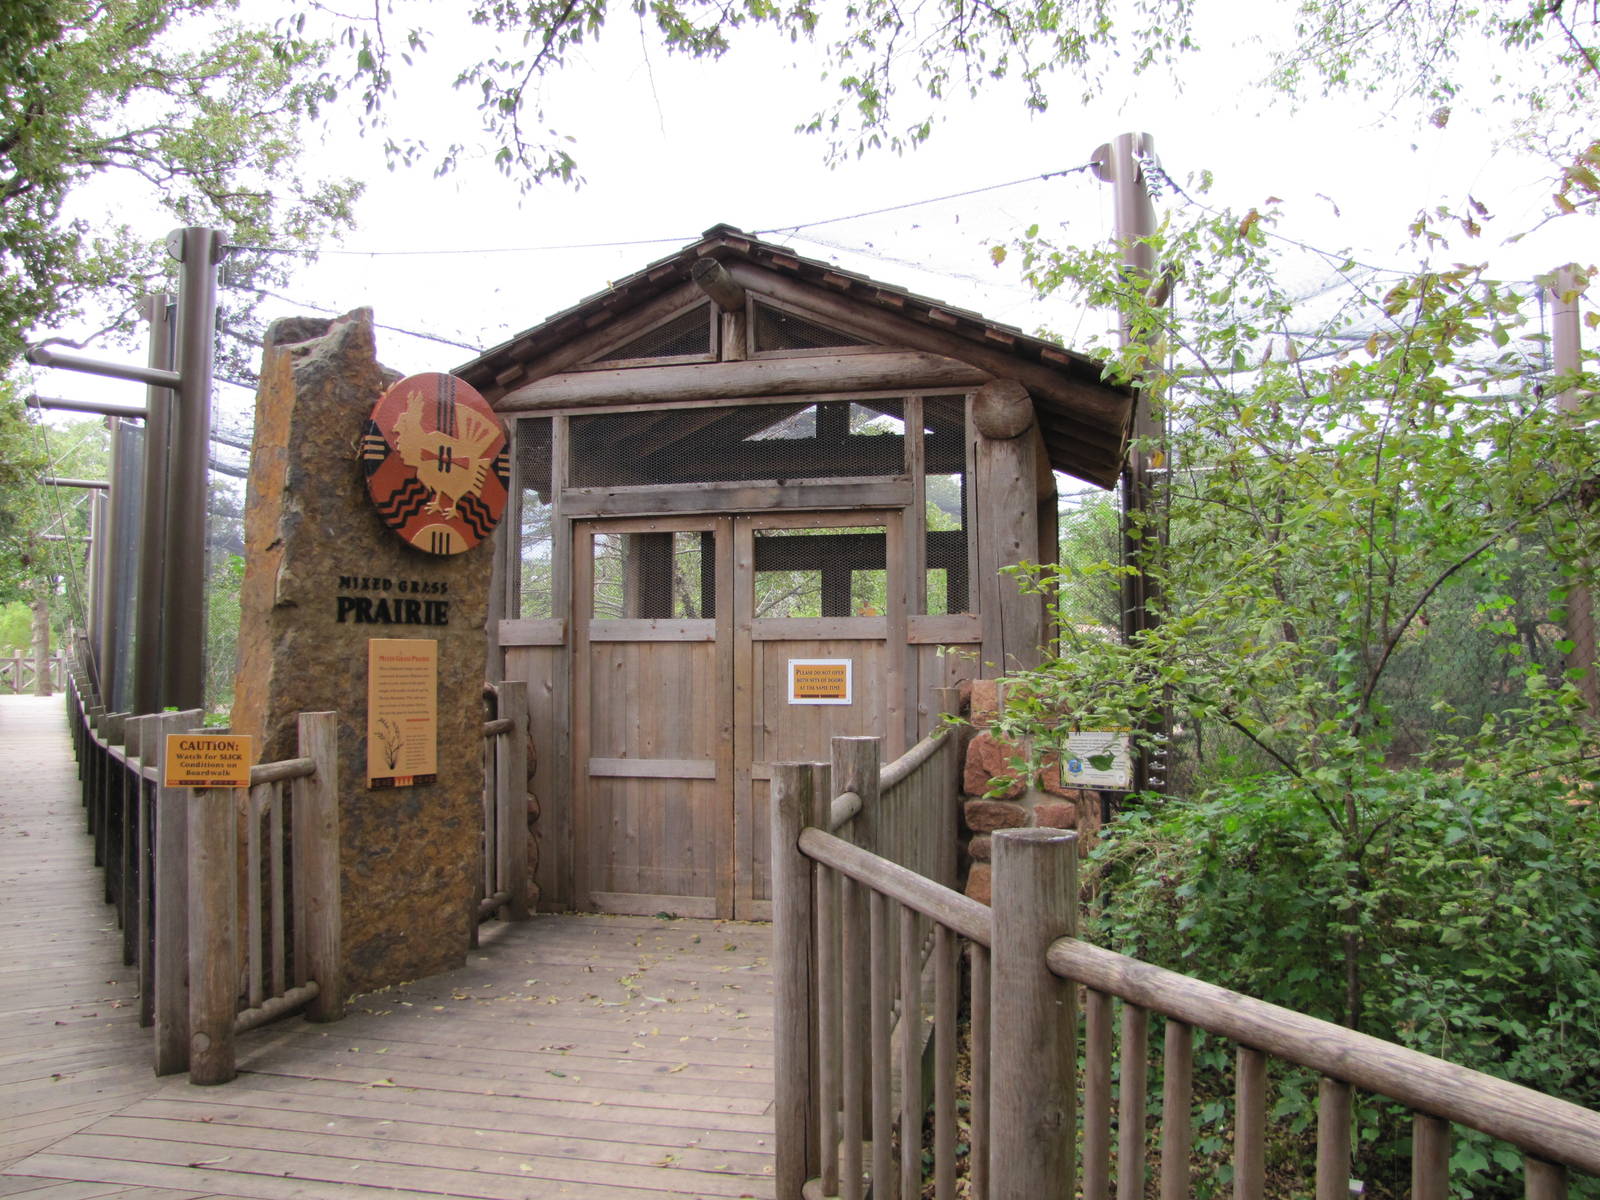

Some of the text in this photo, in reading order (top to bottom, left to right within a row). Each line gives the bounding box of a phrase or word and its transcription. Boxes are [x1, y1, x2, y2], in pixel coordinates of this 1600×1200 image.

[338, 575, 448, 594] MIXED GRASS
[336, 596, 449, 626] PRAIRIE
[179, 740, 239, 751] CAUTION:
